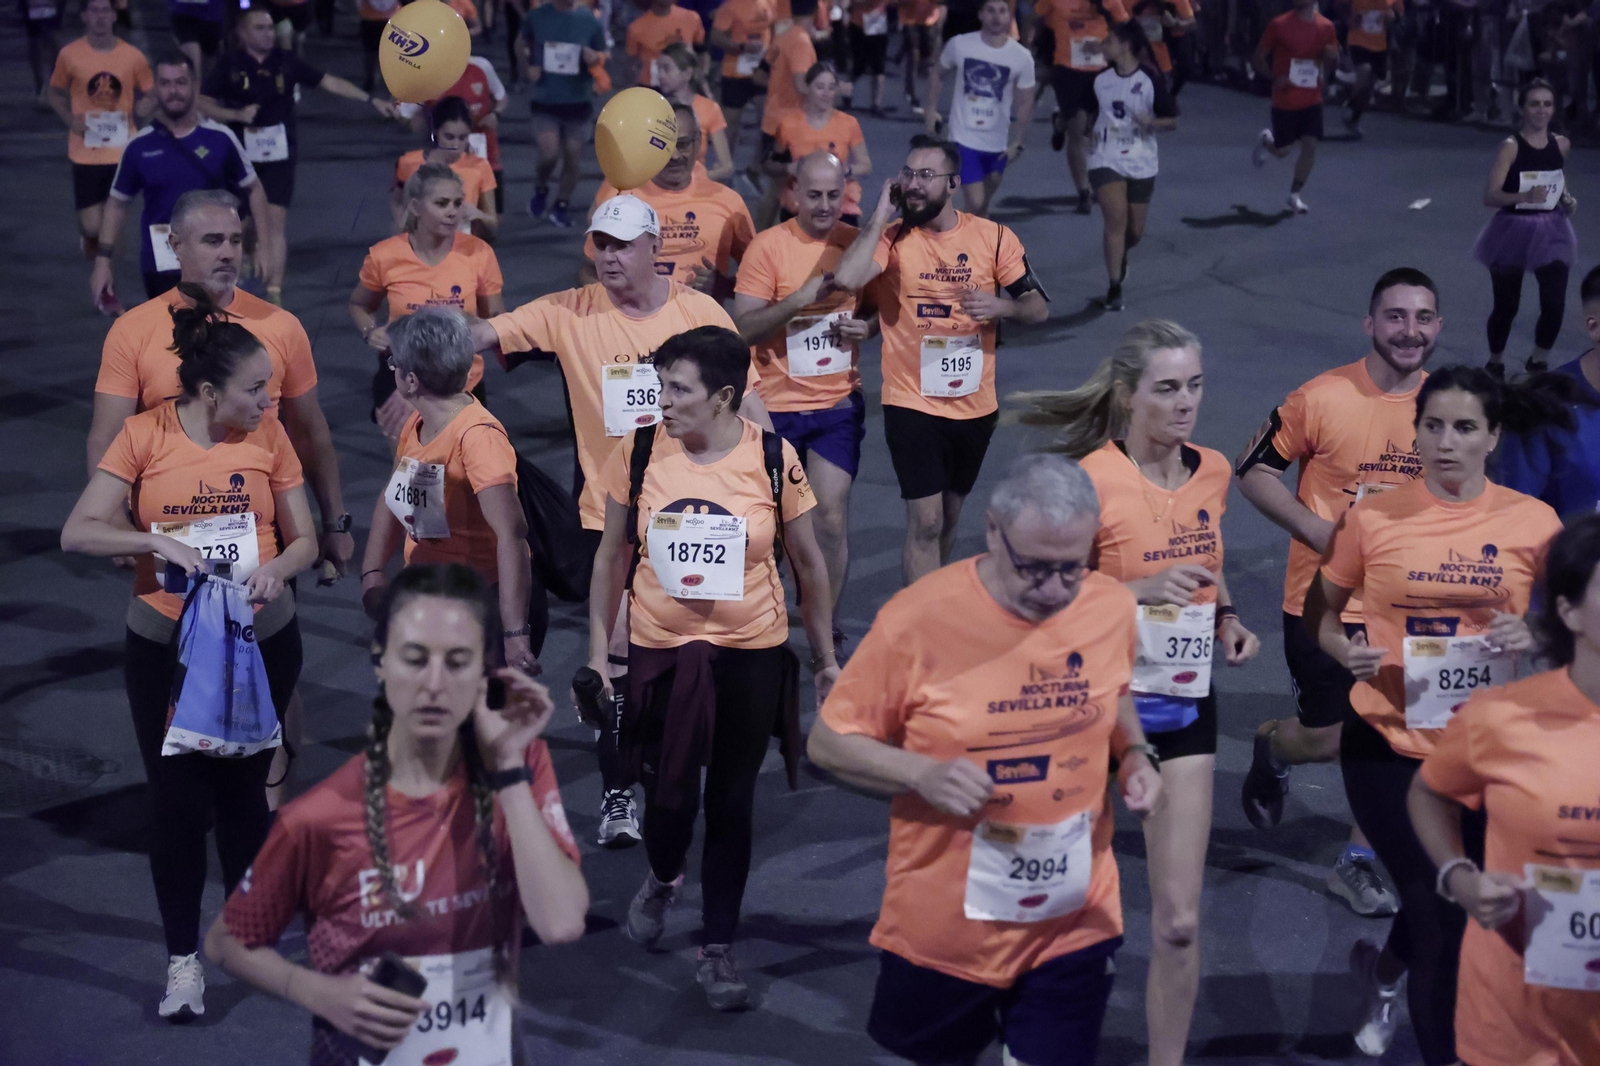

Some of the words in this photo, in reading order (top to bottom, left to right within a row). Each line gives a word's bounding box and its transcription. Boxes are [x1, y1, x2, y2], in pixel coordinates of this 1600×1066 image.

[399, 56, 421, 69] SEVILLA
[919, 272, 950, 282] SEVILLA
[935, 267, 972, 275] NOCTURNA
[804, 334, 842, 351] 19772
[941, 356, 971, 373] 5195
[626, 388, 662, 406] 536
[1358, 463, 1397, 473] SEVILLA
[191, 494, 251, 504] NOCTURNA
[395, 482, 428, 508] 21681
[163, 503, 218, 515] SEVILLA
[1168, 531, 1216, 547] NOCTURNA
[193, 543, 239, 562] 738
[668, 542, 726, 564] 18752
[1143, 546, 1193, 562] SEVILLA
[1439, 563, 1504, 575] NOCTURNA
[683, 576, 701, 585] KH7
[1407, 571, 1467, 585] SEVILLA
[1166, 636, 1211, 659] 3736
[1439, 665, 1491, 690] 8254
[1021, 680, 1090, 696] NOCTURNA
[987, 697, 1052, 714] SEVILLA
[1009, 853, 1068, 881] 2994
[417, 994, 486, 1033] 3914
